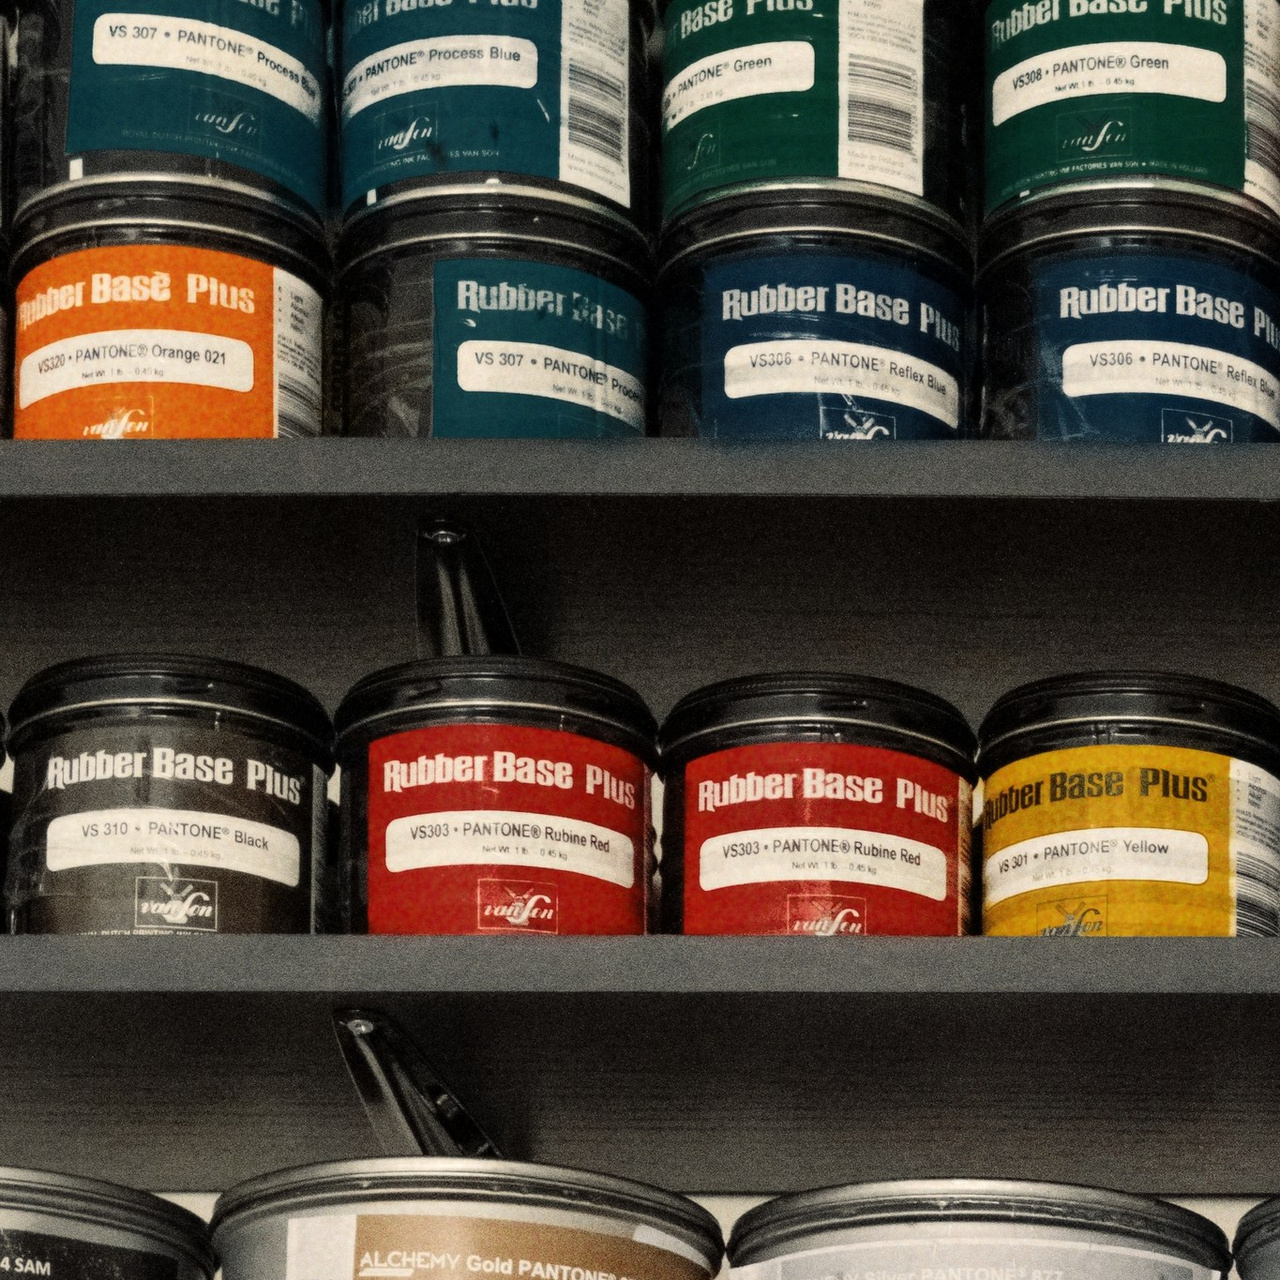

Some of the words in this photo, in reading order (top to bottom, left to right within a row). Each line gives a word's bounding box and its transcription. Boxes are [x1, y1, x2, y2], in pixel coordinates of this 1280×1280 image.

[109, 26, 127, 38] VS
[133, 28, 157, 40] 307
[429, 47, 484, 62] Process
[490, 47, 520, 62] Blue
[735, 56, 771, 72] Green
[1012, 68, 1042, 90] VS308
[1130, 55, 1168, 70] Green
[187, 274, 254, 313] Plus
[722, 284, 829, 320] Rubber
[836, 283, 909, 325] Base
[38, 353, 65, 375] VS320
[152, 344, 200, 364] Orange
[205, 348, 226, 365] 021
[475, 352, 494, 364] VS
[499, 353, 522, 366] 307
[1090, 353, 1132, 366] VS306
[890, 363, 924, 384] Reflex
[48, 752, 146, 790] Rubber
[247, 759, 301, 805] Plus
[384, 752, 488, 793] Rubber
[493, 751, 573, 789] Base
[586, 765, 635, 809] Plus
[803, 767, 883, 803] Base
[103, 822, 128, 836] 310
[234, 830, 269, 850] Black
[410, 823, 449, 840] VS303
[545, 826, 587, 847] Rubine
[590, 834, 610, 853] Red
[1123, 841, 1169, 856] Yellow
[722, 841, 760, 859] VS303
[854, 841, 897, 861] Rubine
[900, 849, 921, 866] Red
[15, 1257, 52, 1276] SAM
[360, 1251, 459, 1269] ALCHEMY
[466, 1254, 512, 1275] Gold
